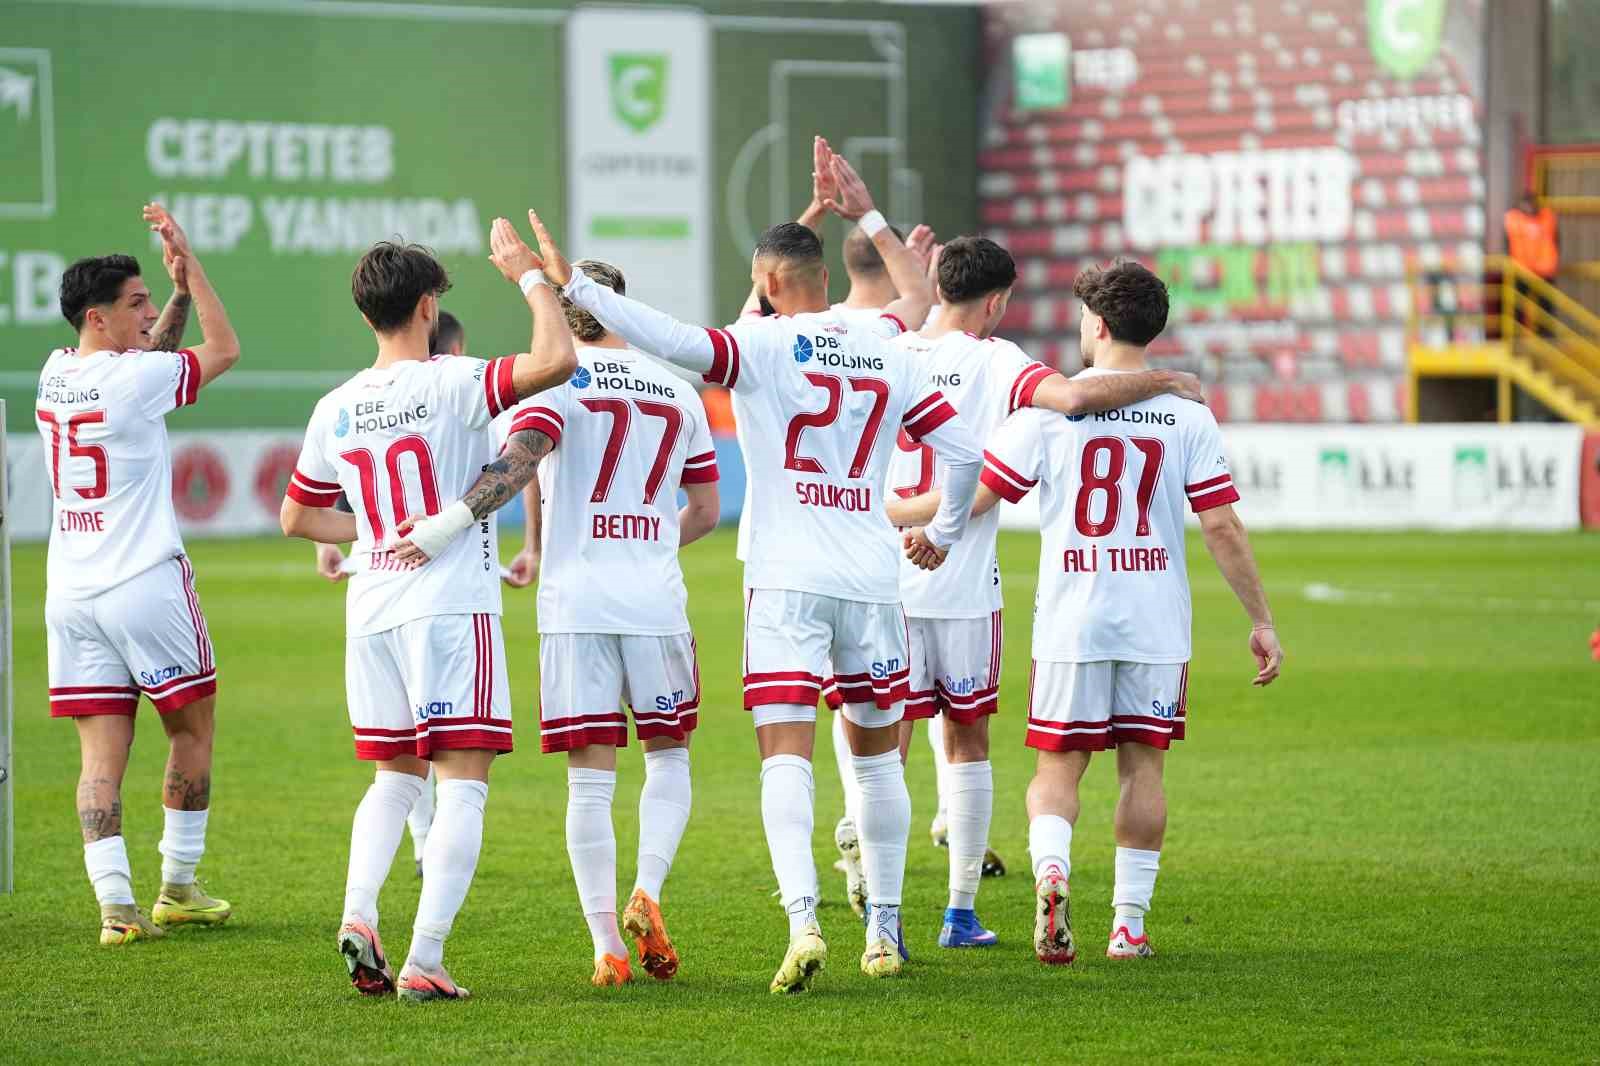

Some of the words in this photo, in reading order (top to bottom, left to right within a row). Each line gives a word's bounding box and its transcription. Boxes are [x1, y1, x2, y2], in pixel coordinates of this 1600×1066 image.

[147, 118, 394, 182] CEPTETEB
[815, 336, 841, 348] DB
[596, 377, 675, 398] HOLDING
[355, 404, 428, 434] HOLDING
[784, 370, 891, 478] 27
[1094, 409, 1176, 426] HOLDING
[36, 409, 109, 499] 15
[578, 397, 684, 505] 77
[338, 433, 442, 543] 10
[795, 482, 871, 511] SOUKOU
[60, 510, 105, 532] EMRE
[592, 514, 661, 541] BENNY
[1063, 544, 1097, 573] ALİ
